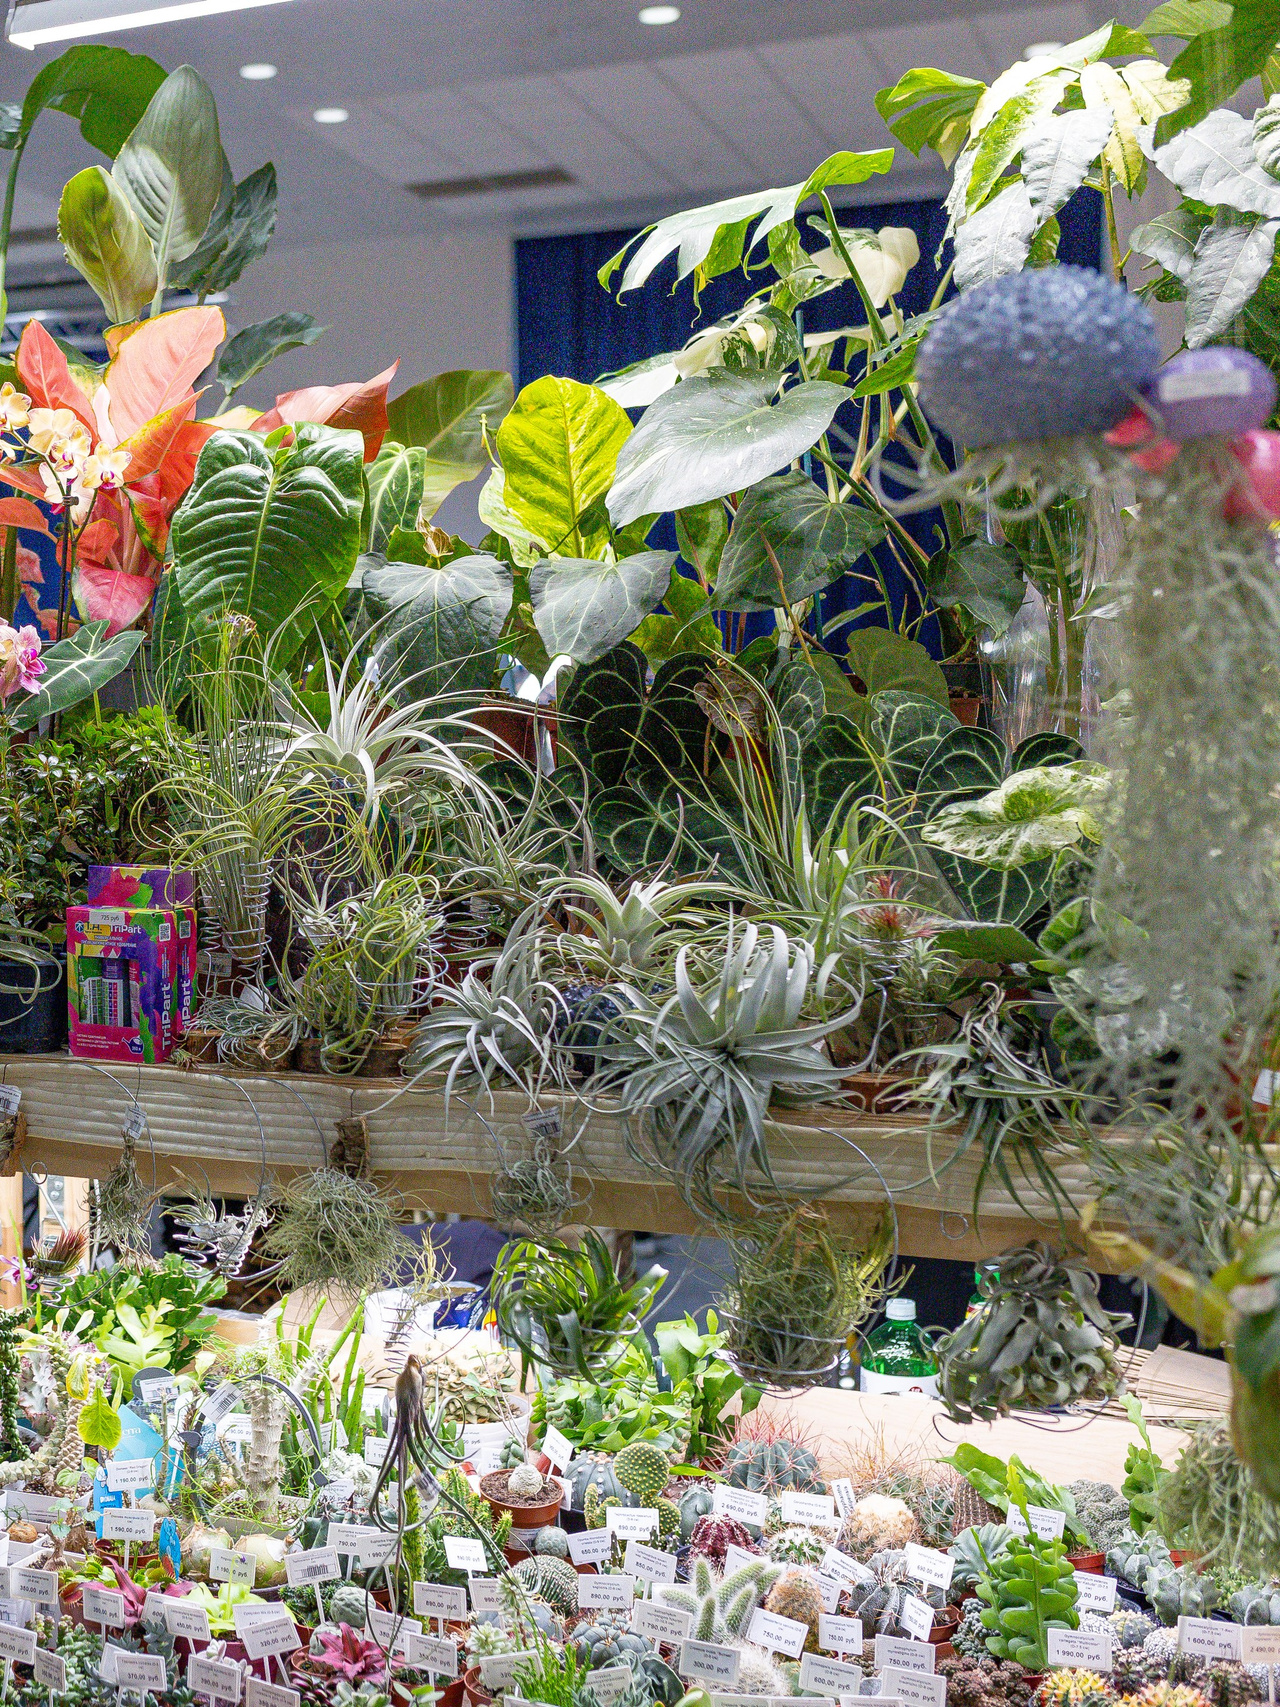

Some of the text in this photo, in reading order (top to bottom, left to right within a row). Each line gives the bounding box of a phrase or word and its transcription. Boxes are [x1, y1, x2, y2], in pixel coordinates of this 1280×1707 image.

[110, 924, 142, 934] TriPart
[182, 979, 191, 1030] riPart
[162, 982, 171, 1050] TriPart
[726, 1504, 744, 1513] 690,00
[763, 1630, 782, 1641] 750,00
[828, 1634, 843, 1642] 750,00
[1193, 1638, 1215, 1646] 600,00
[1062, 1650, 1084, 1658] 990,00
[889, 1658, 910, 1667] 750,00
[814, 1677, 834, 1687] 600,00
[897, 1688, 919, 1698] 750,00
